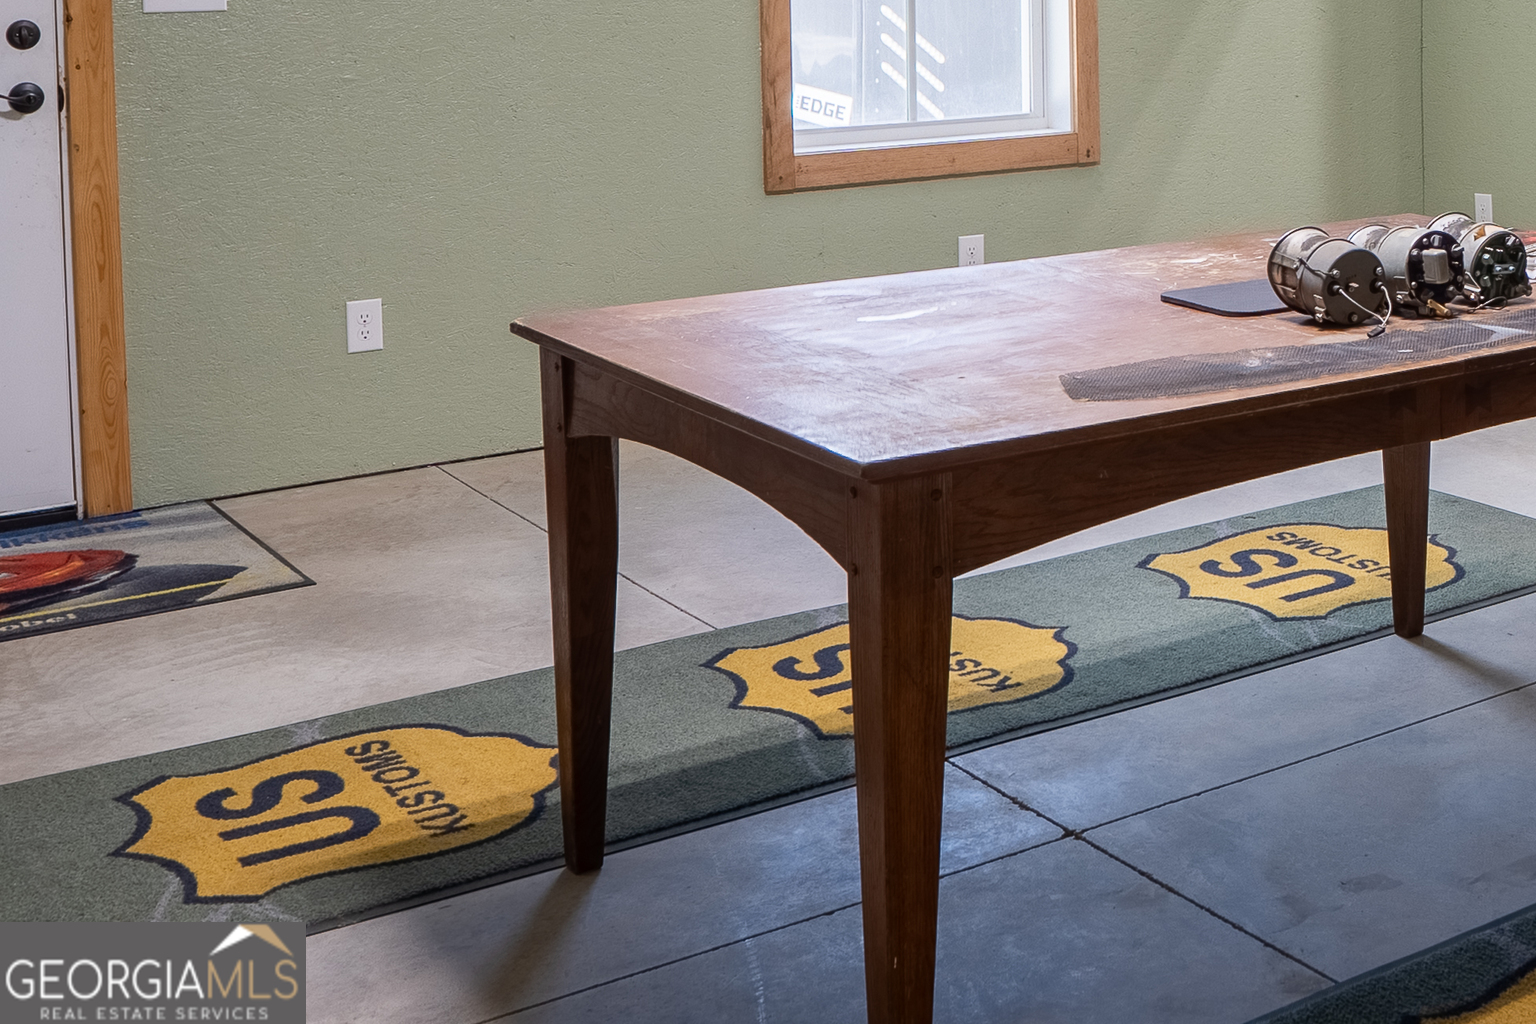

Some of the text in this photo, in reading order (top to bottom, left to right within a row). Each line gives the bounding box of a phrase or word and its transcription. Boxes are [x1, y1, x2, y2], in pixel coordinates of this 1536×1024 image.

[800, 95, 847, 121] EDGE
[1200, 549, 1356, 603] US
[196, 769, 381, 868] US
[345, 739, 476, 837] KUSTOMS
